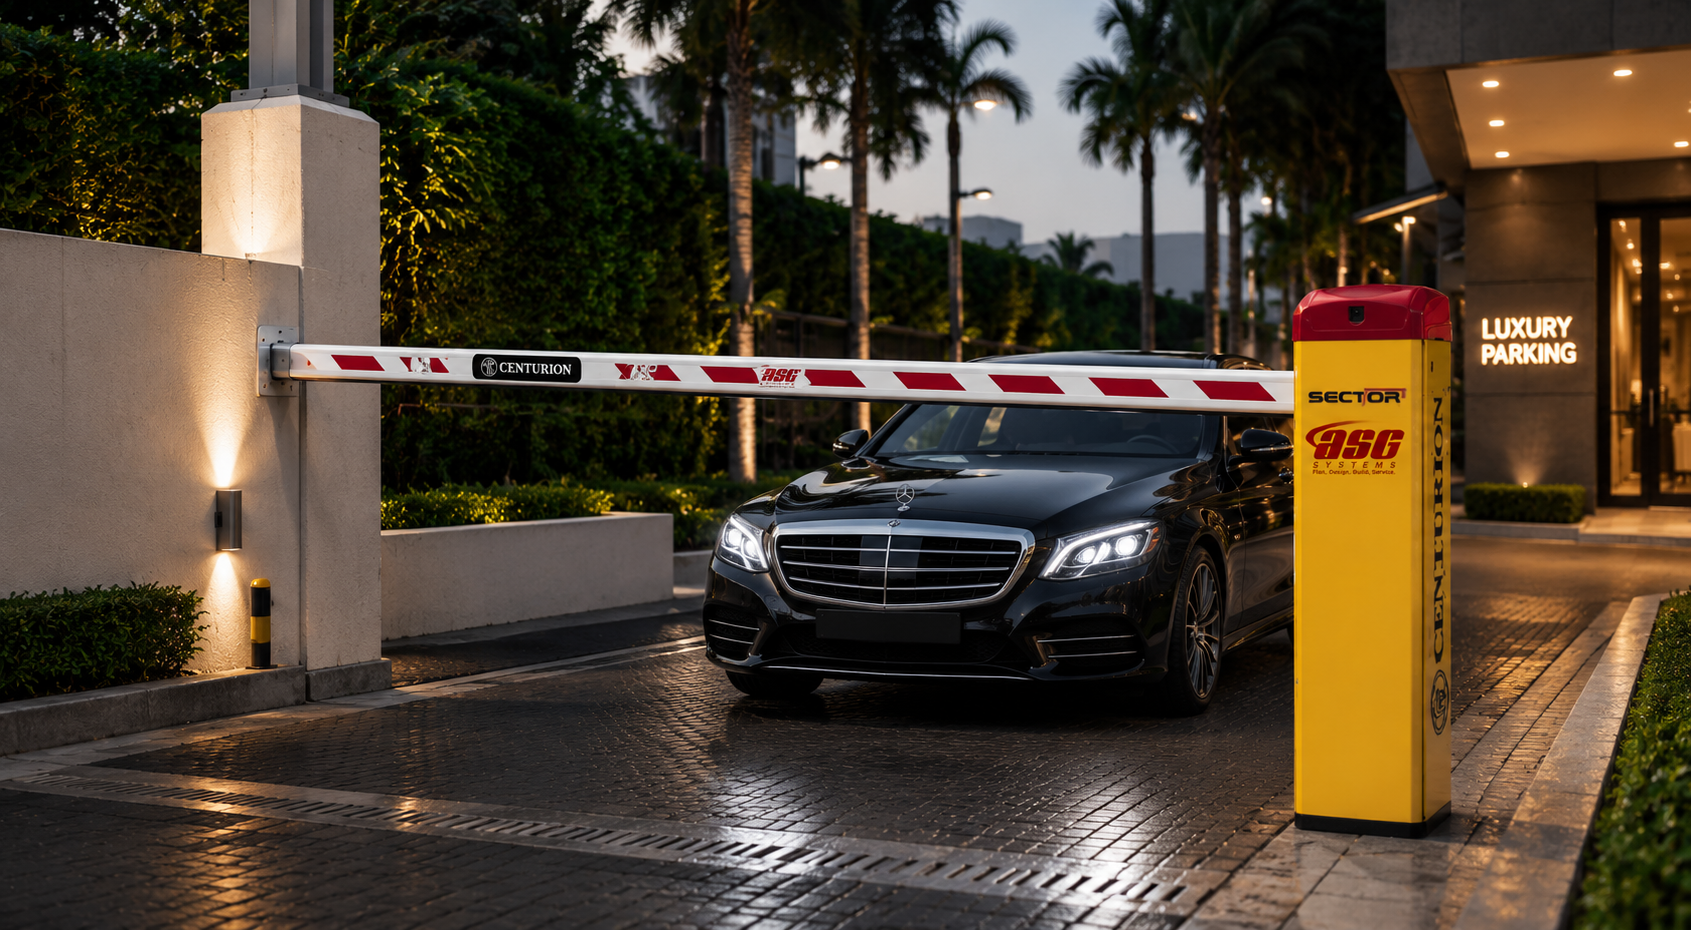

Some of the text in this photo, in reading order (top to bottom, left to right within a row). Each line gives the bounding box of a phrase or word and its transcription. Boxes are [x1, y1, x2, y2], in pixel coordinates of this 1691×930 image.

[1481, 315, 1573, 340] LUXURY
[1481, 342, 1578, 366] PARKING
[499, 361, 572, 375] CENTURION
[1308, 389, 1404, 405] SECTOR
[1312, 461, 1396, 469] SYSTEMS
[1432, 397, 1444, 664] CENTURION
